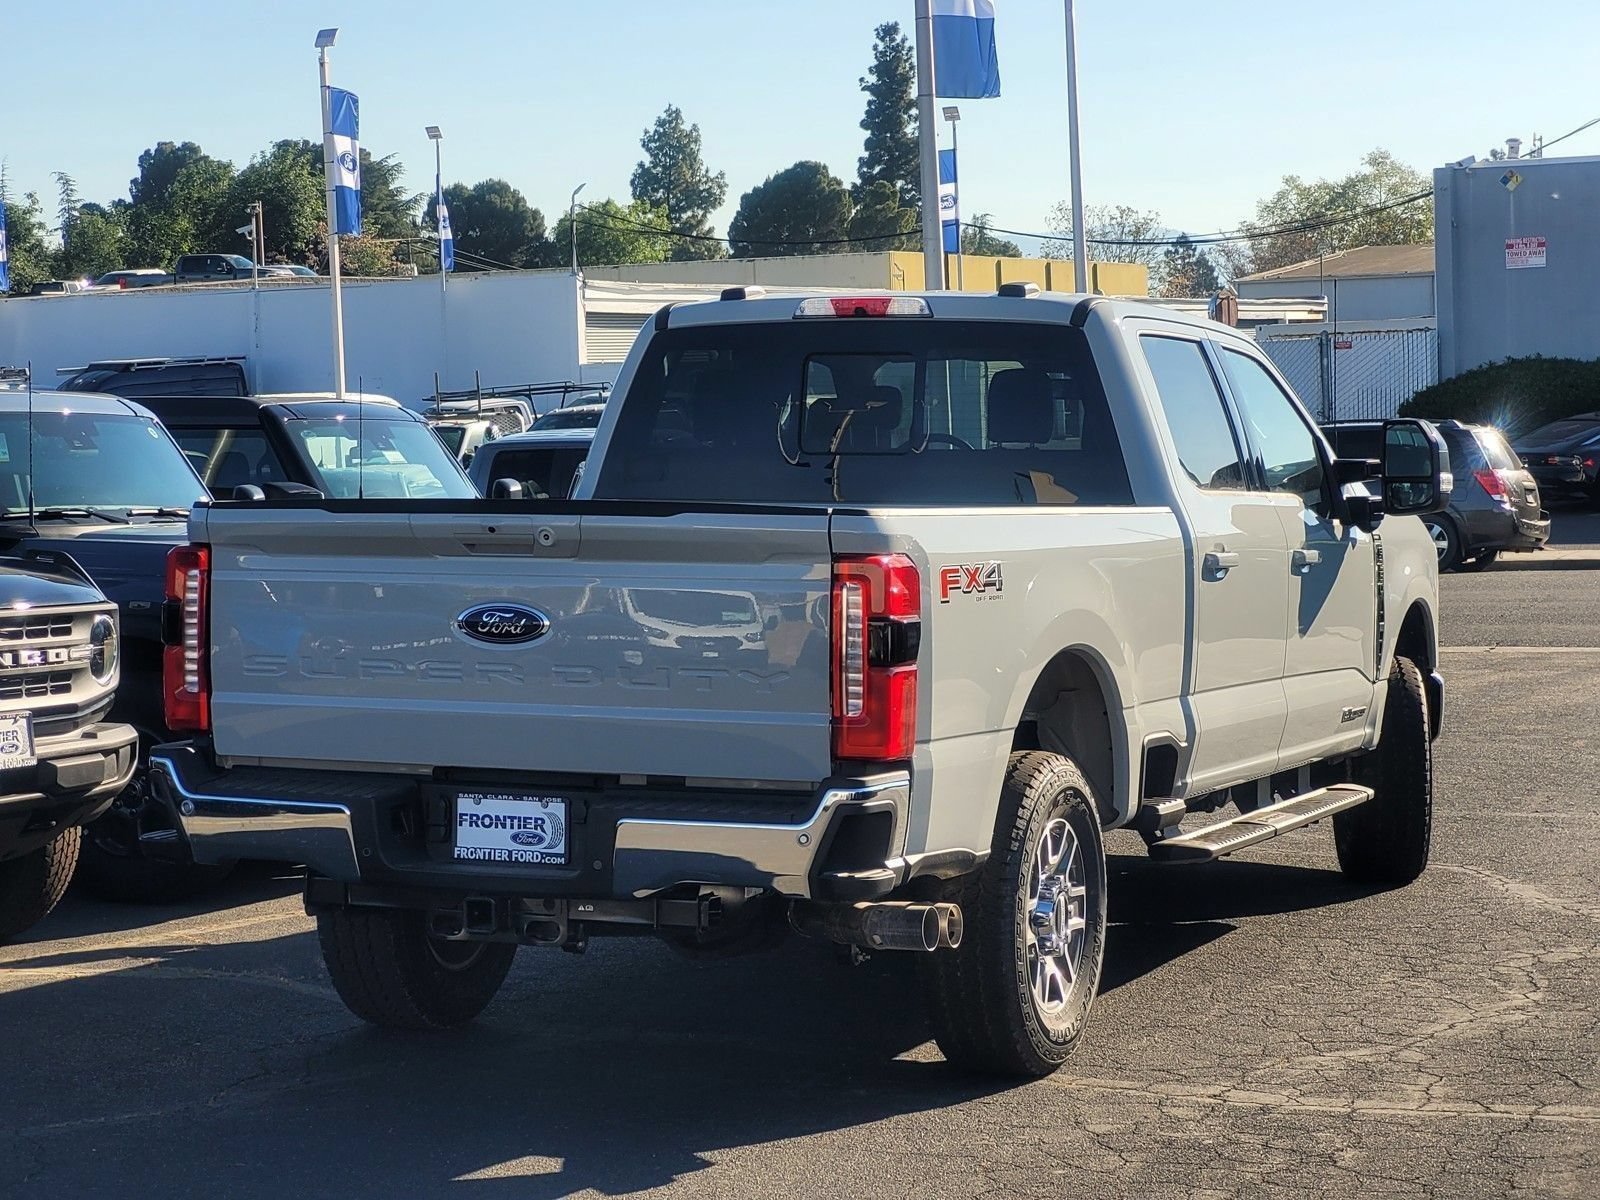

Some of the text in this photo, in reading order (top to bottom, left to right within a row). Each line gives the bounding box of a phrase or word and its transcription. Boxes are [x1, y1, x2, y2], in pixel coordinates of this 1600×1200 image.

[940, 562, 1003, 604] FX4
[478, 611, 526, 634] Ford
[243, 655, 792, 694] SUPER DUTY
[458, 812, 547, 836] FRONTIER
[516, 833, 539, 845] Ford
[454, 847, 510, 862] FRONTIER
